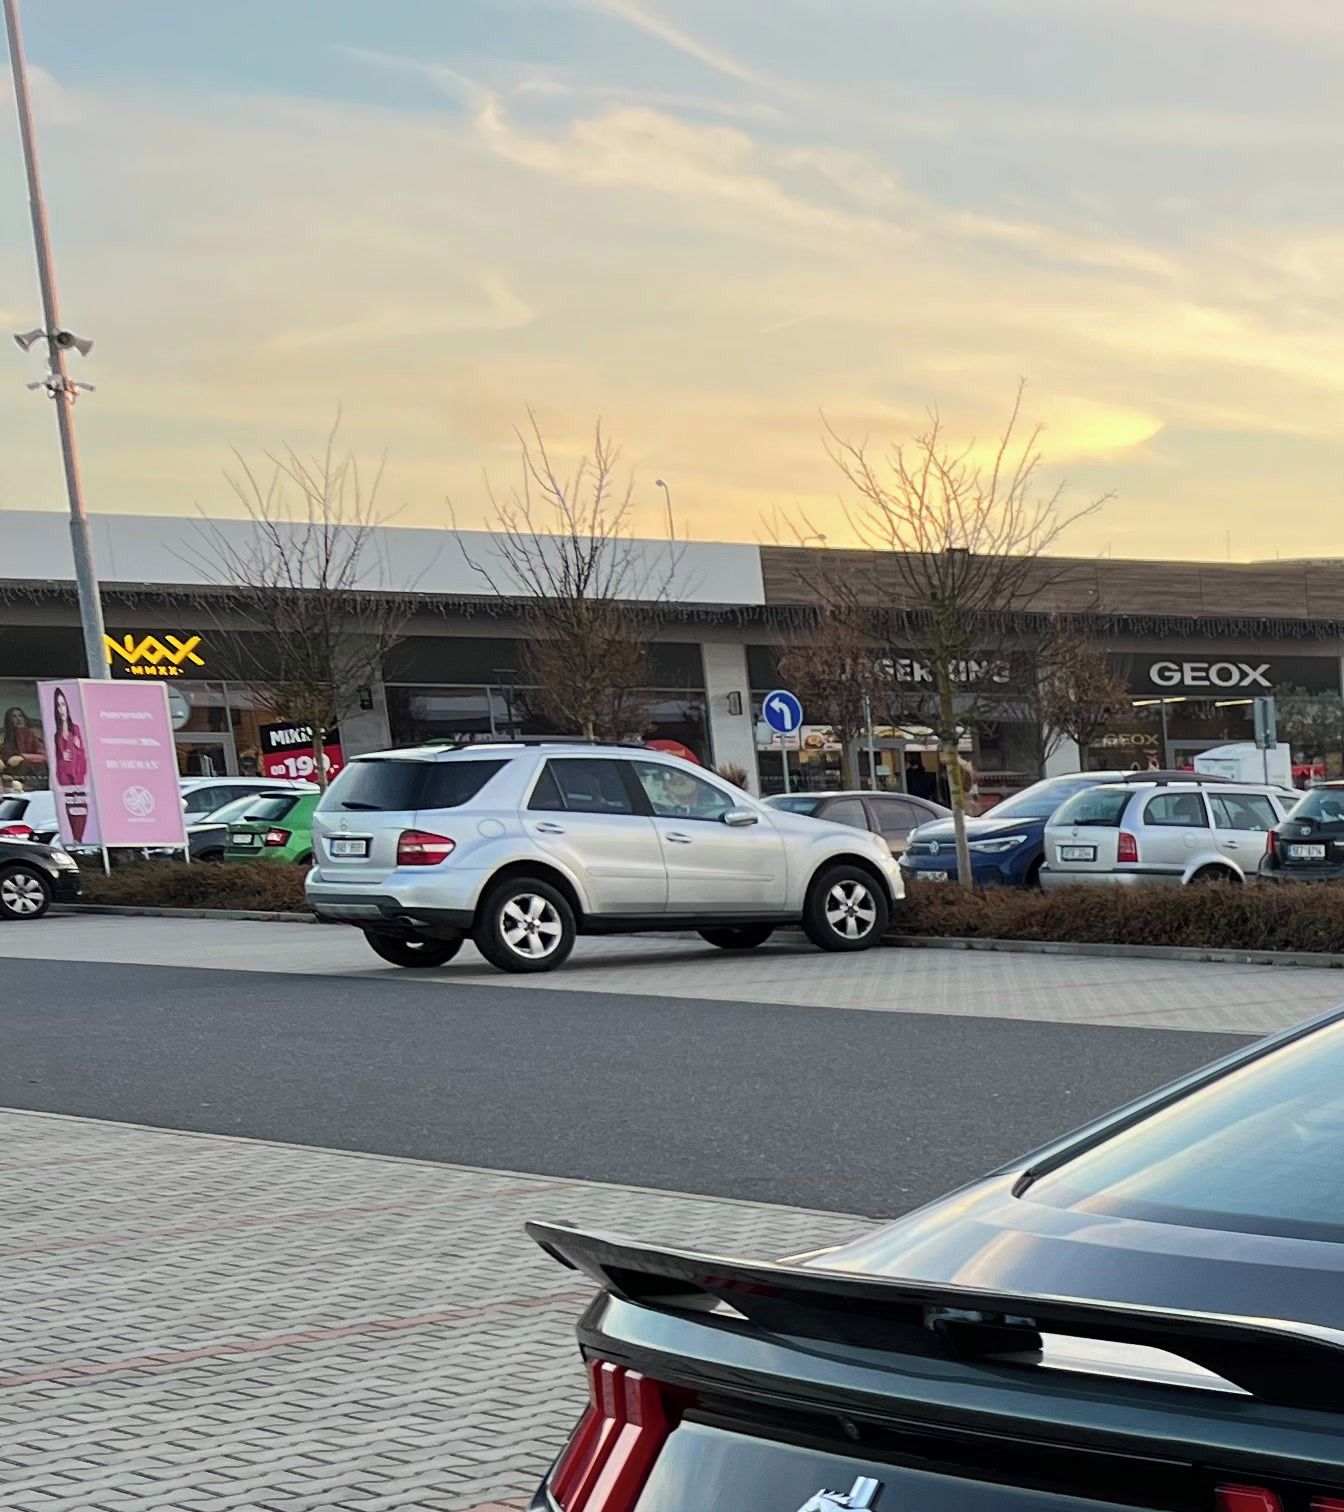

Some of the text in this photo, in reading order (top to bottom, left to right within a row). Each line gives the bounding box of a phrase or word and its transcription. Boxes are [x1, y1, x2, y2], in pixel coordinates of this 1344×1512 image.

[103, 634, 205, 665] NAX
[1149, 661, 1273, 687] GEOX
[1103, 733, 1160, 745] GEOX
